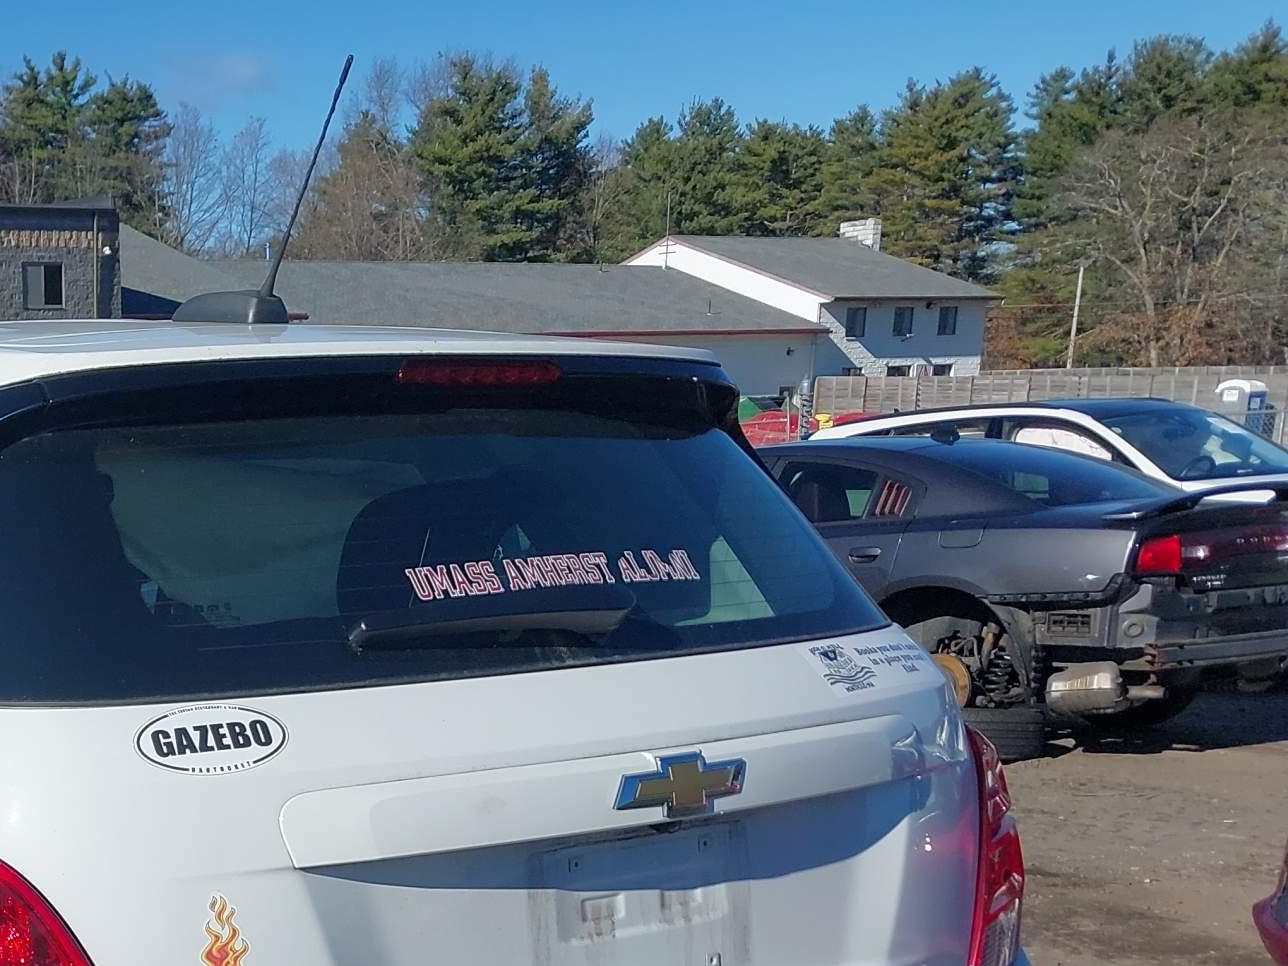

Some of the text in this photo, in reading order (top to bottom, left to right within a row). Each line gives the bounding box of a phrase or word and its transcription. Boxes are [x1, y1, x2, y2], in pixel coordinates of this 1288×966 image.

[405, 549, 701, 601] UMASS AMHERST ALUMNI
[150, 719, 273, 758] GAZEBO
